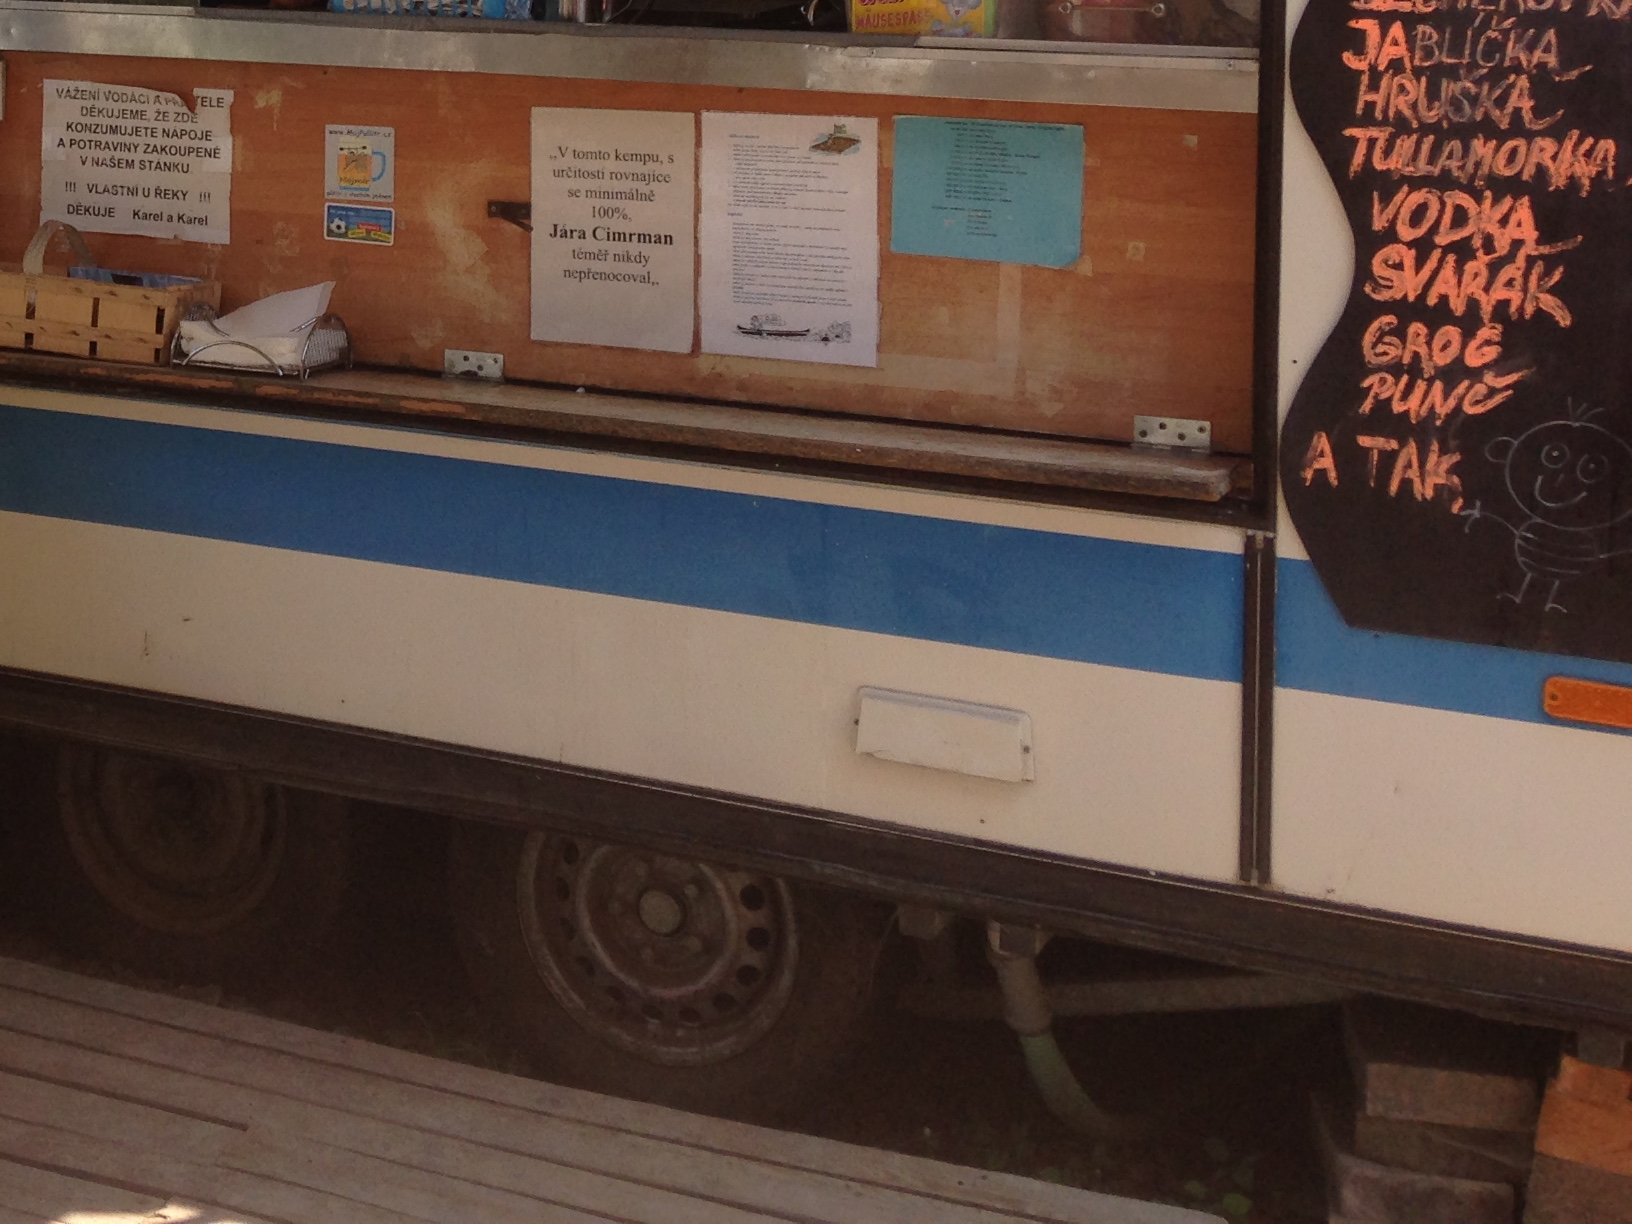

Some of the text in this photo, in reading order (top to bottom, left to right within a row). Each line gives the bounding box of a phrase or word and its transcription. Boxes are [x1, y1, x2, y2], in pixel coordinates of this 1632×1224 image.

[1342, 13, 1594, 82] JABLÍČKA
[56, 86, 100, 102] VÁŽENÍ
[102, 89, 150, 105] VODÁCI
[1356, 65, 1565, 131] HRUŠKA
[80, 104, 151, 122] DĚKUJEME,
[154, 109, 169, 122] ŽE
[66, 121, 159, 138] KONZUMUJETE
[56, 138, 221, 159] A POTRAVINY ZAKOUPENÉ
[573, 148, 611, 161] tomto
[614, 148, 664, 165] kempu,
[667, 154, 675, 164] s
[79, 155, 190, 174] V NAŠEM STÁNKU
[86, 182, 189, 201] VLASTNÍ U ŘEKY
[567, 186, 656, 202] se minimálně
[67, 202, 208, 226] DĚKUJE Karel a Karel
[1372, 183, 1583, 257] VODKA
[549, 223, 674, 245] Jára Cimrman
[572, 247, 651, 268] téměř nikdy
[1362, 314, 1504, 377] GROG
[1359, 367, 1537, 426] PUNČ
[1302, 430, 1338, 487] A
